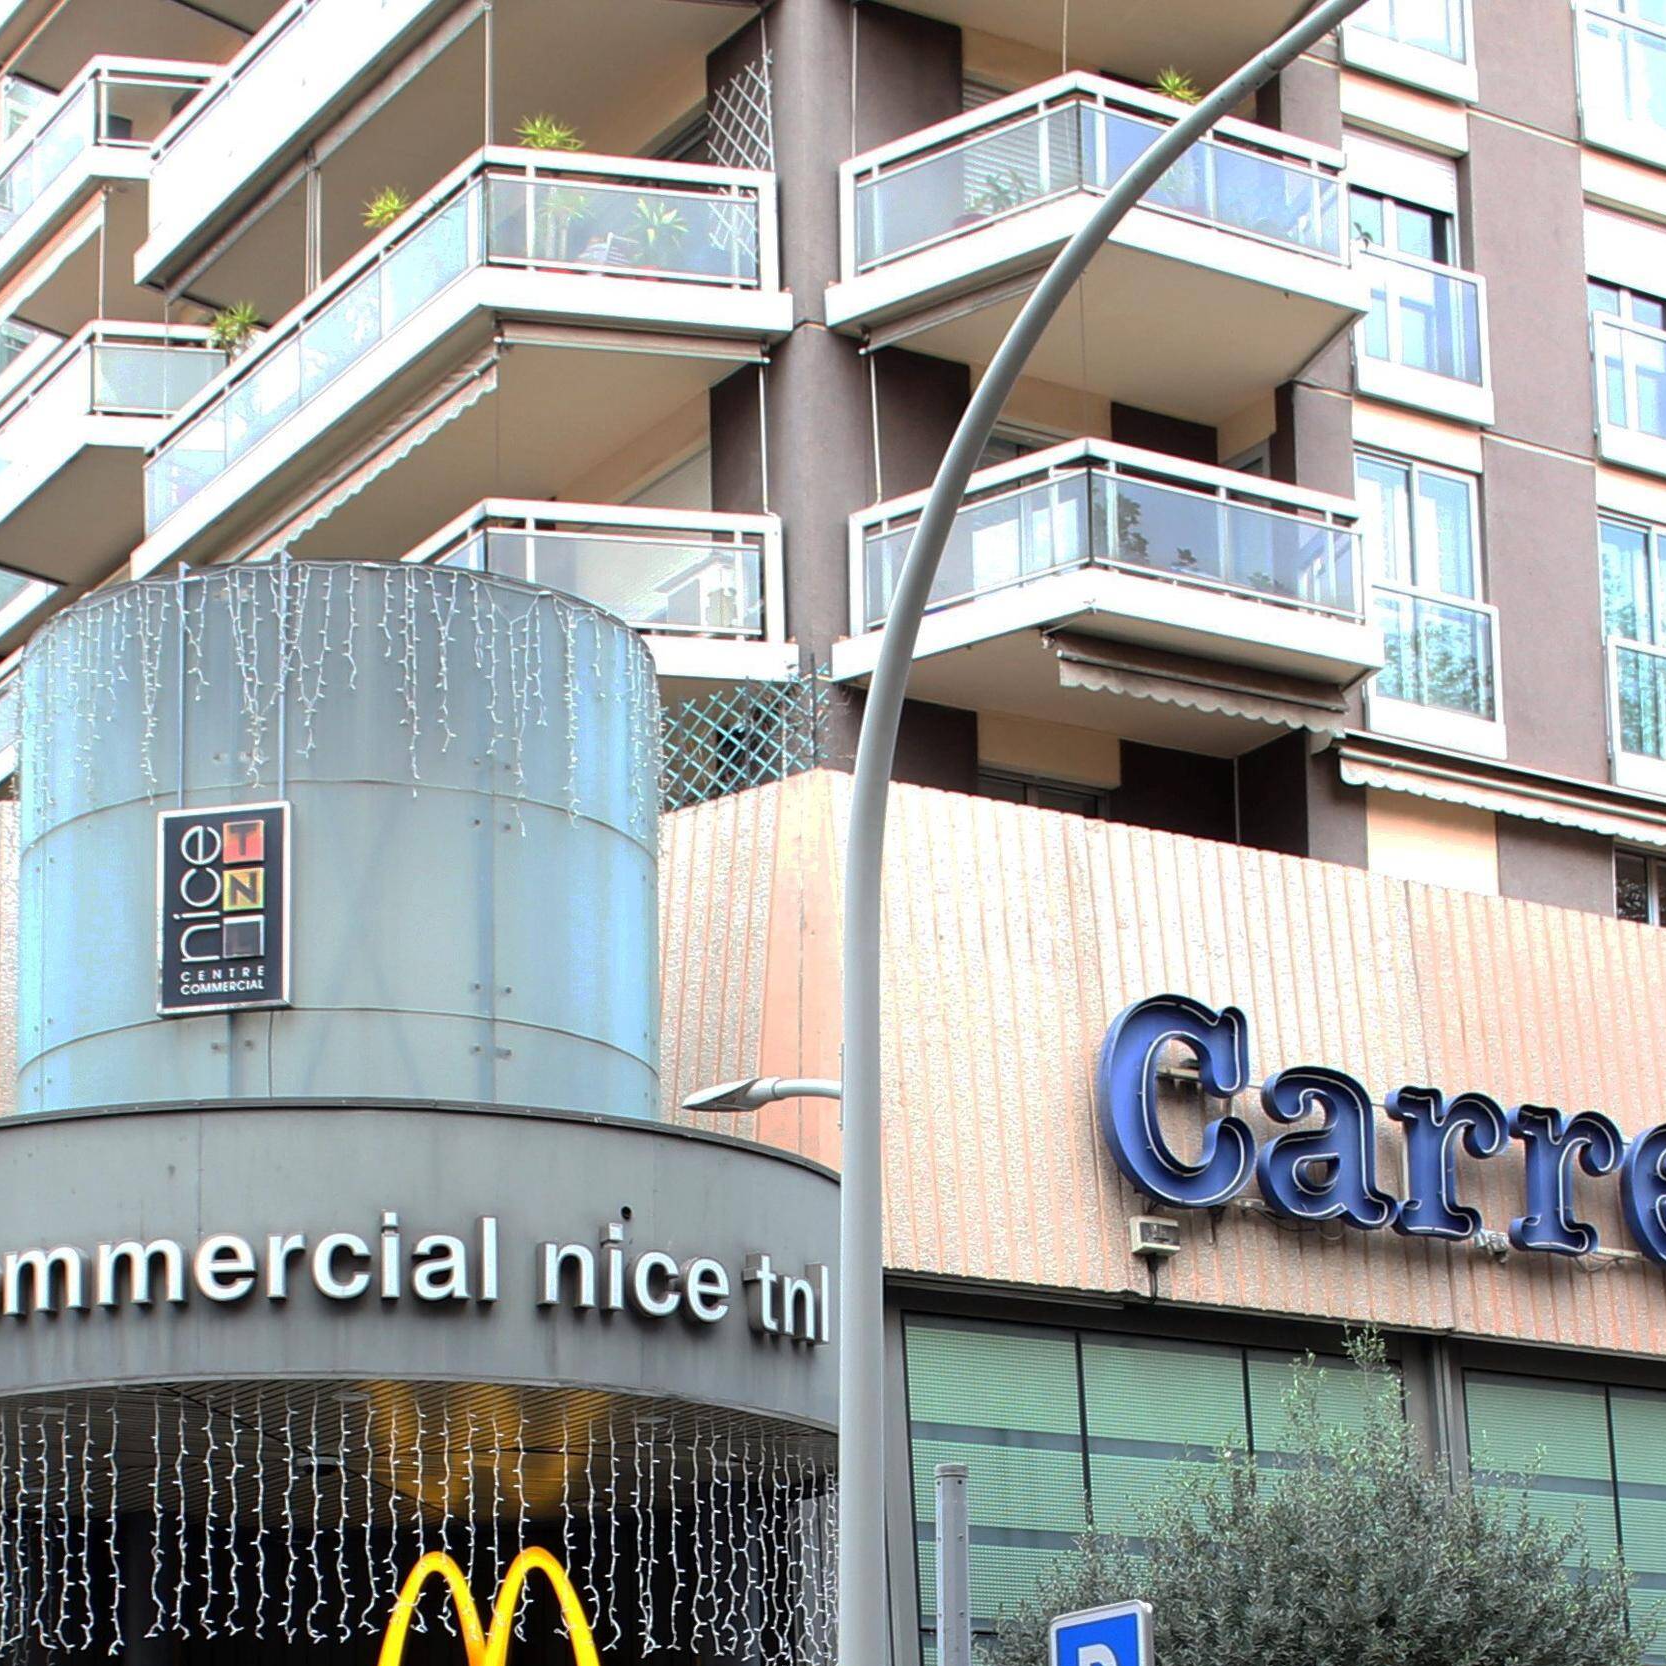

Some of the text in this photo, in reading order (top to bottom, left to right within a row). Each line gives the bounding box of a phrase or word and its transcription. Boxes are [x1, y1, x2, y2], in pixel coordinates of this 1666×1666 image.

[173, 825, 222, 962] nice
[180, 965, 265, 983] CENTRE
[180, 979, 265, 996] COMMERCIAL
[536, 1222, 730, 1323] nice
[743, 1250, 830, 1345] tnl
